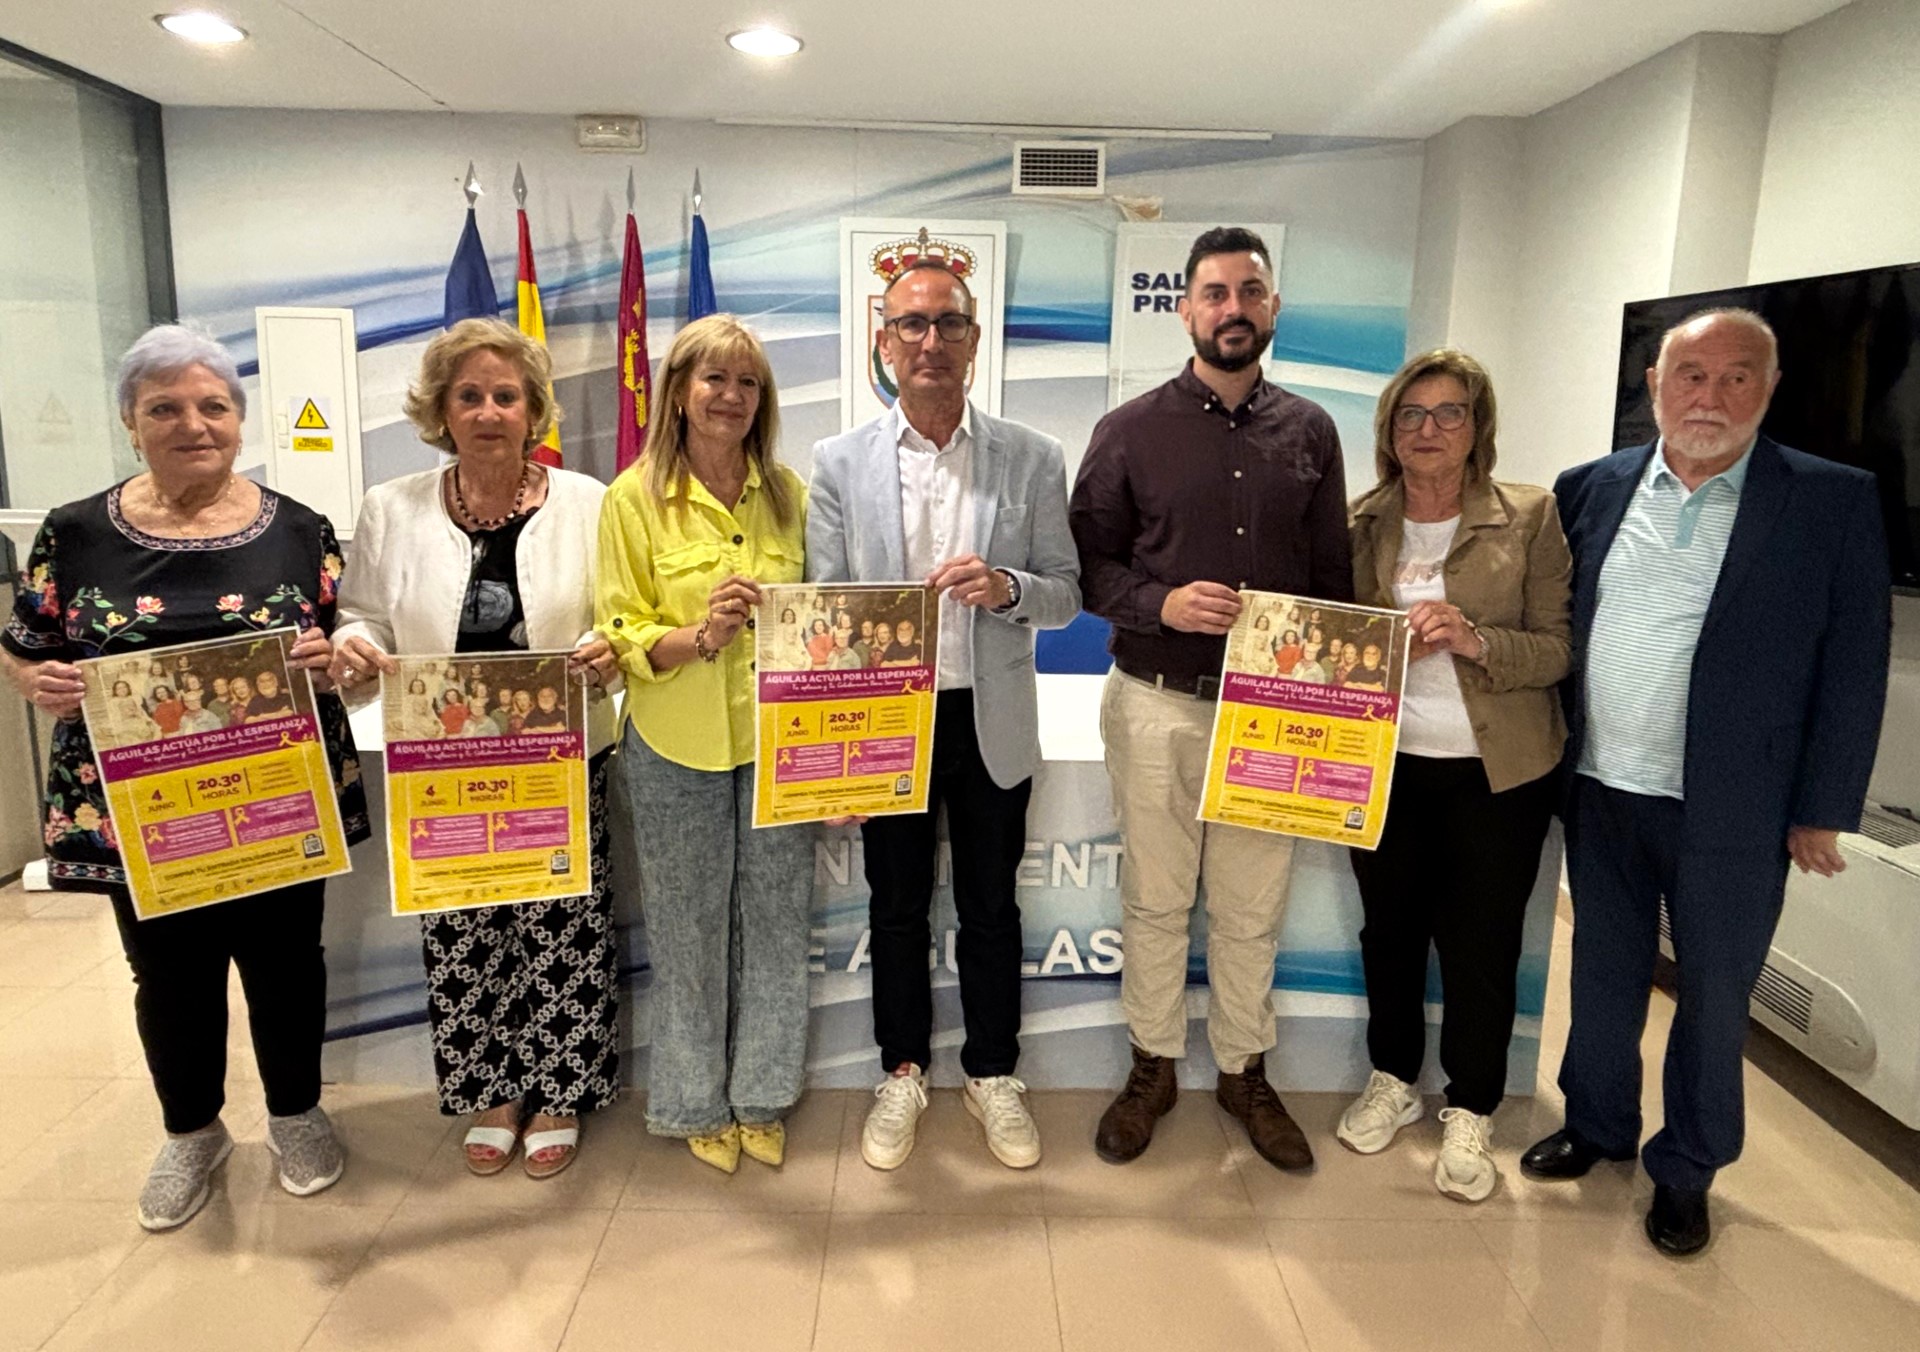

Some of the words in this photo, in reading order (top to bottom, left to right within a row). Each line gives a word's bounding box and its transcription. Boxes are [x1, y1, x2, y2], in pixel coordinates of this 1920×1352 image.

[1131, 273, 1186, 291] SAL
[765, 673, 807, 684] ÁGUILAS
[808, 671, 841, 682] ACTÚA
[843, 672, 861, 680] POR
[877, 669, 928, 679] ESPERANZA
[1231, 675, 1271, 689] ÁGUILAS
[1272, 681, 1304, 693] ACTÚA
[1306, 686, 1325, 695] POR
[1327, 690, 1338, 698] LA
[1340, 691, 1393, 707] ESPERANZA
[791, 716, 800, 727] 4
[829, 711, 864, 723] 20.30
[831, 724, 860, 732] HORAS
[1249, 719, 1258, 729] 4
[786, 729, 808, 737] JUNIO
[1242, 732, 1265, 740] JUNIO
[1286, 724, 1323, 738] 20.30
[109, 745, 160, 763] ÁGUILAS
[162, 737, 201, 753] ACTÚA
[203, 732, 225, 745] POR
[228, 729, 243, 739] LA
[244, 718, 308, 736] ESPERANZA
[442, 739, 478, 751] ACTÚA
[480, 739, 500, 748] POR
[503, 738, 515, 747] LA
[518, 733, 576, 746] ESPERANZA
[1287, 738, 1317, 748] HORAS
[197, 773, 241, 791] 20.30
[467, 779, 508, 794] 20.30
[152, 790, 162, 801] 4
[202, 788, 239, 801] HORAS
[425, 784, 435, 797] 4
[148, 801, 175, 812] JUNIO
